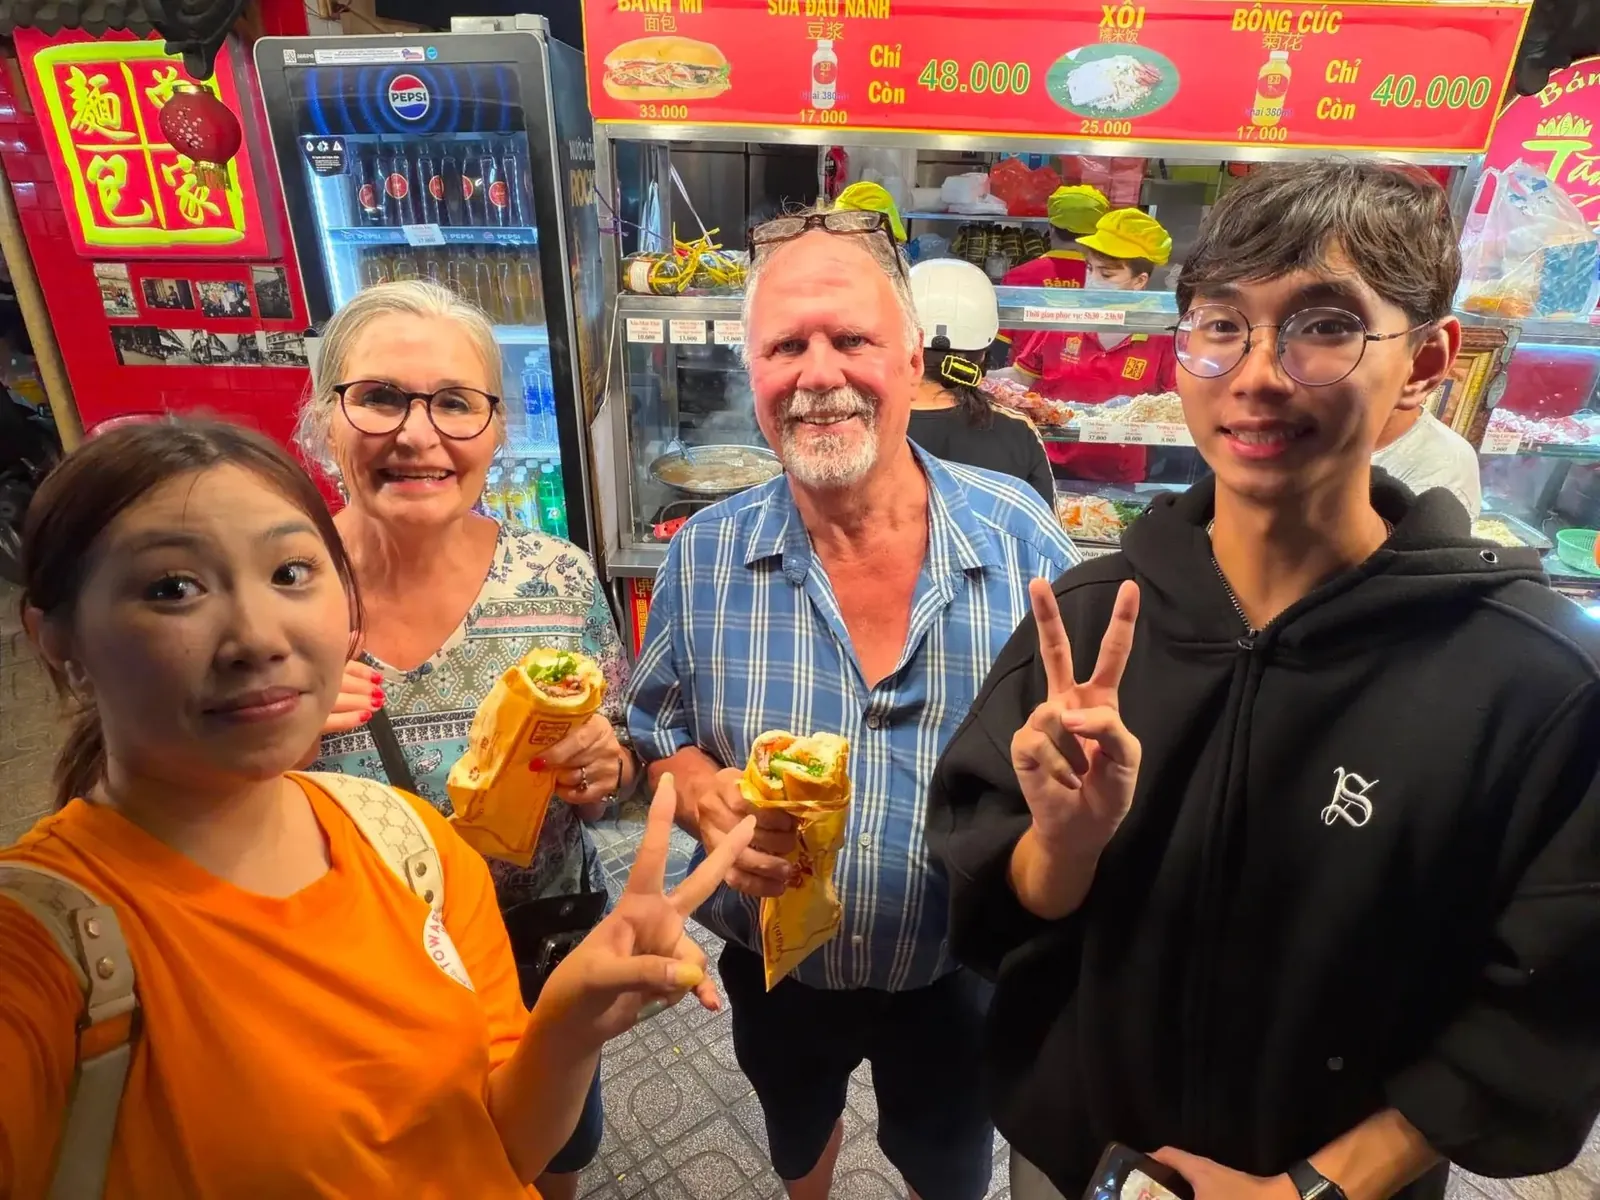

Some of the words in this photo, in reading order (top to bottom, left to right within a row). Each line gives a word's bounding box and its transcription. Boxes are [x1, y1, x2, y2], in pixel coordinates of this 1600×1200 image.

[644, 14, 677, 32] 面包
[1099, 0, 1146, 28] XÔI
[1231, 2, 1293, 33] BÔNG
[1297, 4, 1343, 35] CÚC
[807, 21, 844, 40] 豆浆
[1262, 31, 1306, 51] 菊花
[870, 43, 902, 68] Chỉ
[918, 59, 1031, 95] 48.000
[1325, 58, 1363, 84] Chỉ
[391, 92, 427, 103] PEPSI
[868, 80, 906, 104] Còn
[1370, 74, 1492, 110] 40.000
[640, 104, 688, 119] 33.000
[799, 108, 848, 124] 17.000
[1316, 96, 1357, 120] Còn
[1080, 120, 1132, 136] 25.000
[1237, 125, 1288, 141] 17.000
